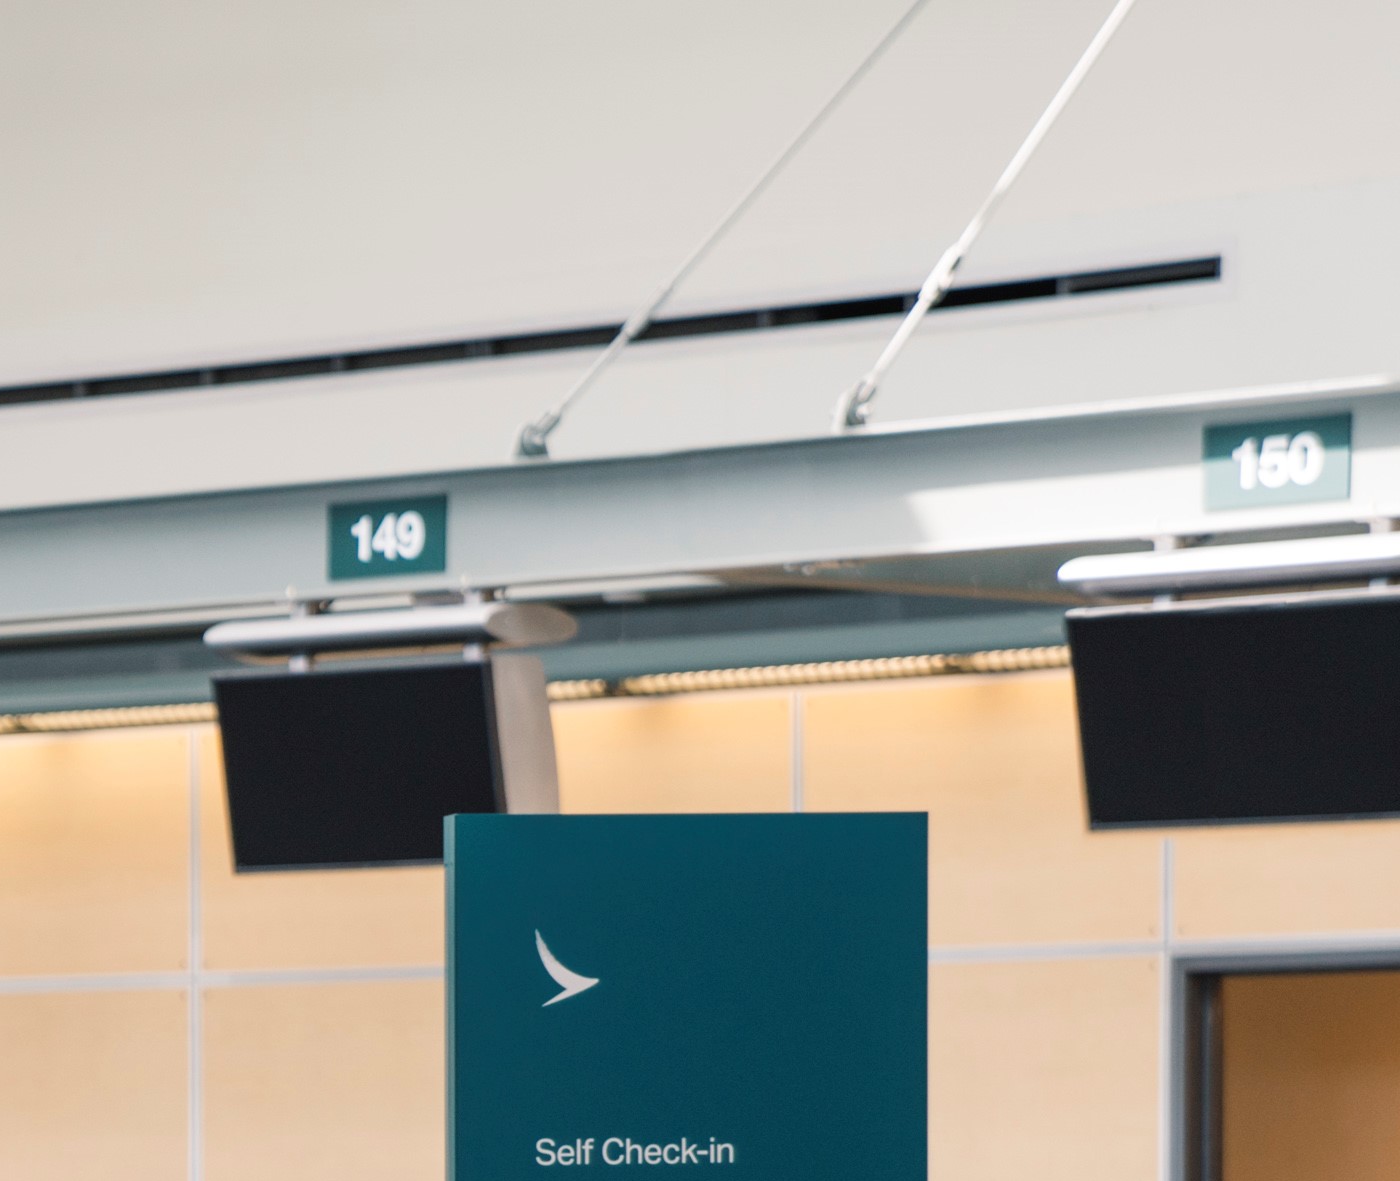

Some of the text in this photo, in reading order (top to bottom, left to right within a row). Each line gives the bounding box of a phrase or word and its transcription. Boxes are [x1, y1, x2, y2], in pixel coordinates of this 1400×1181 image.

[1232, 431, 1324, 490] 150
[350, 511, 426, 563] 149
[535, 1136, 734, 1166] Self Check-in
